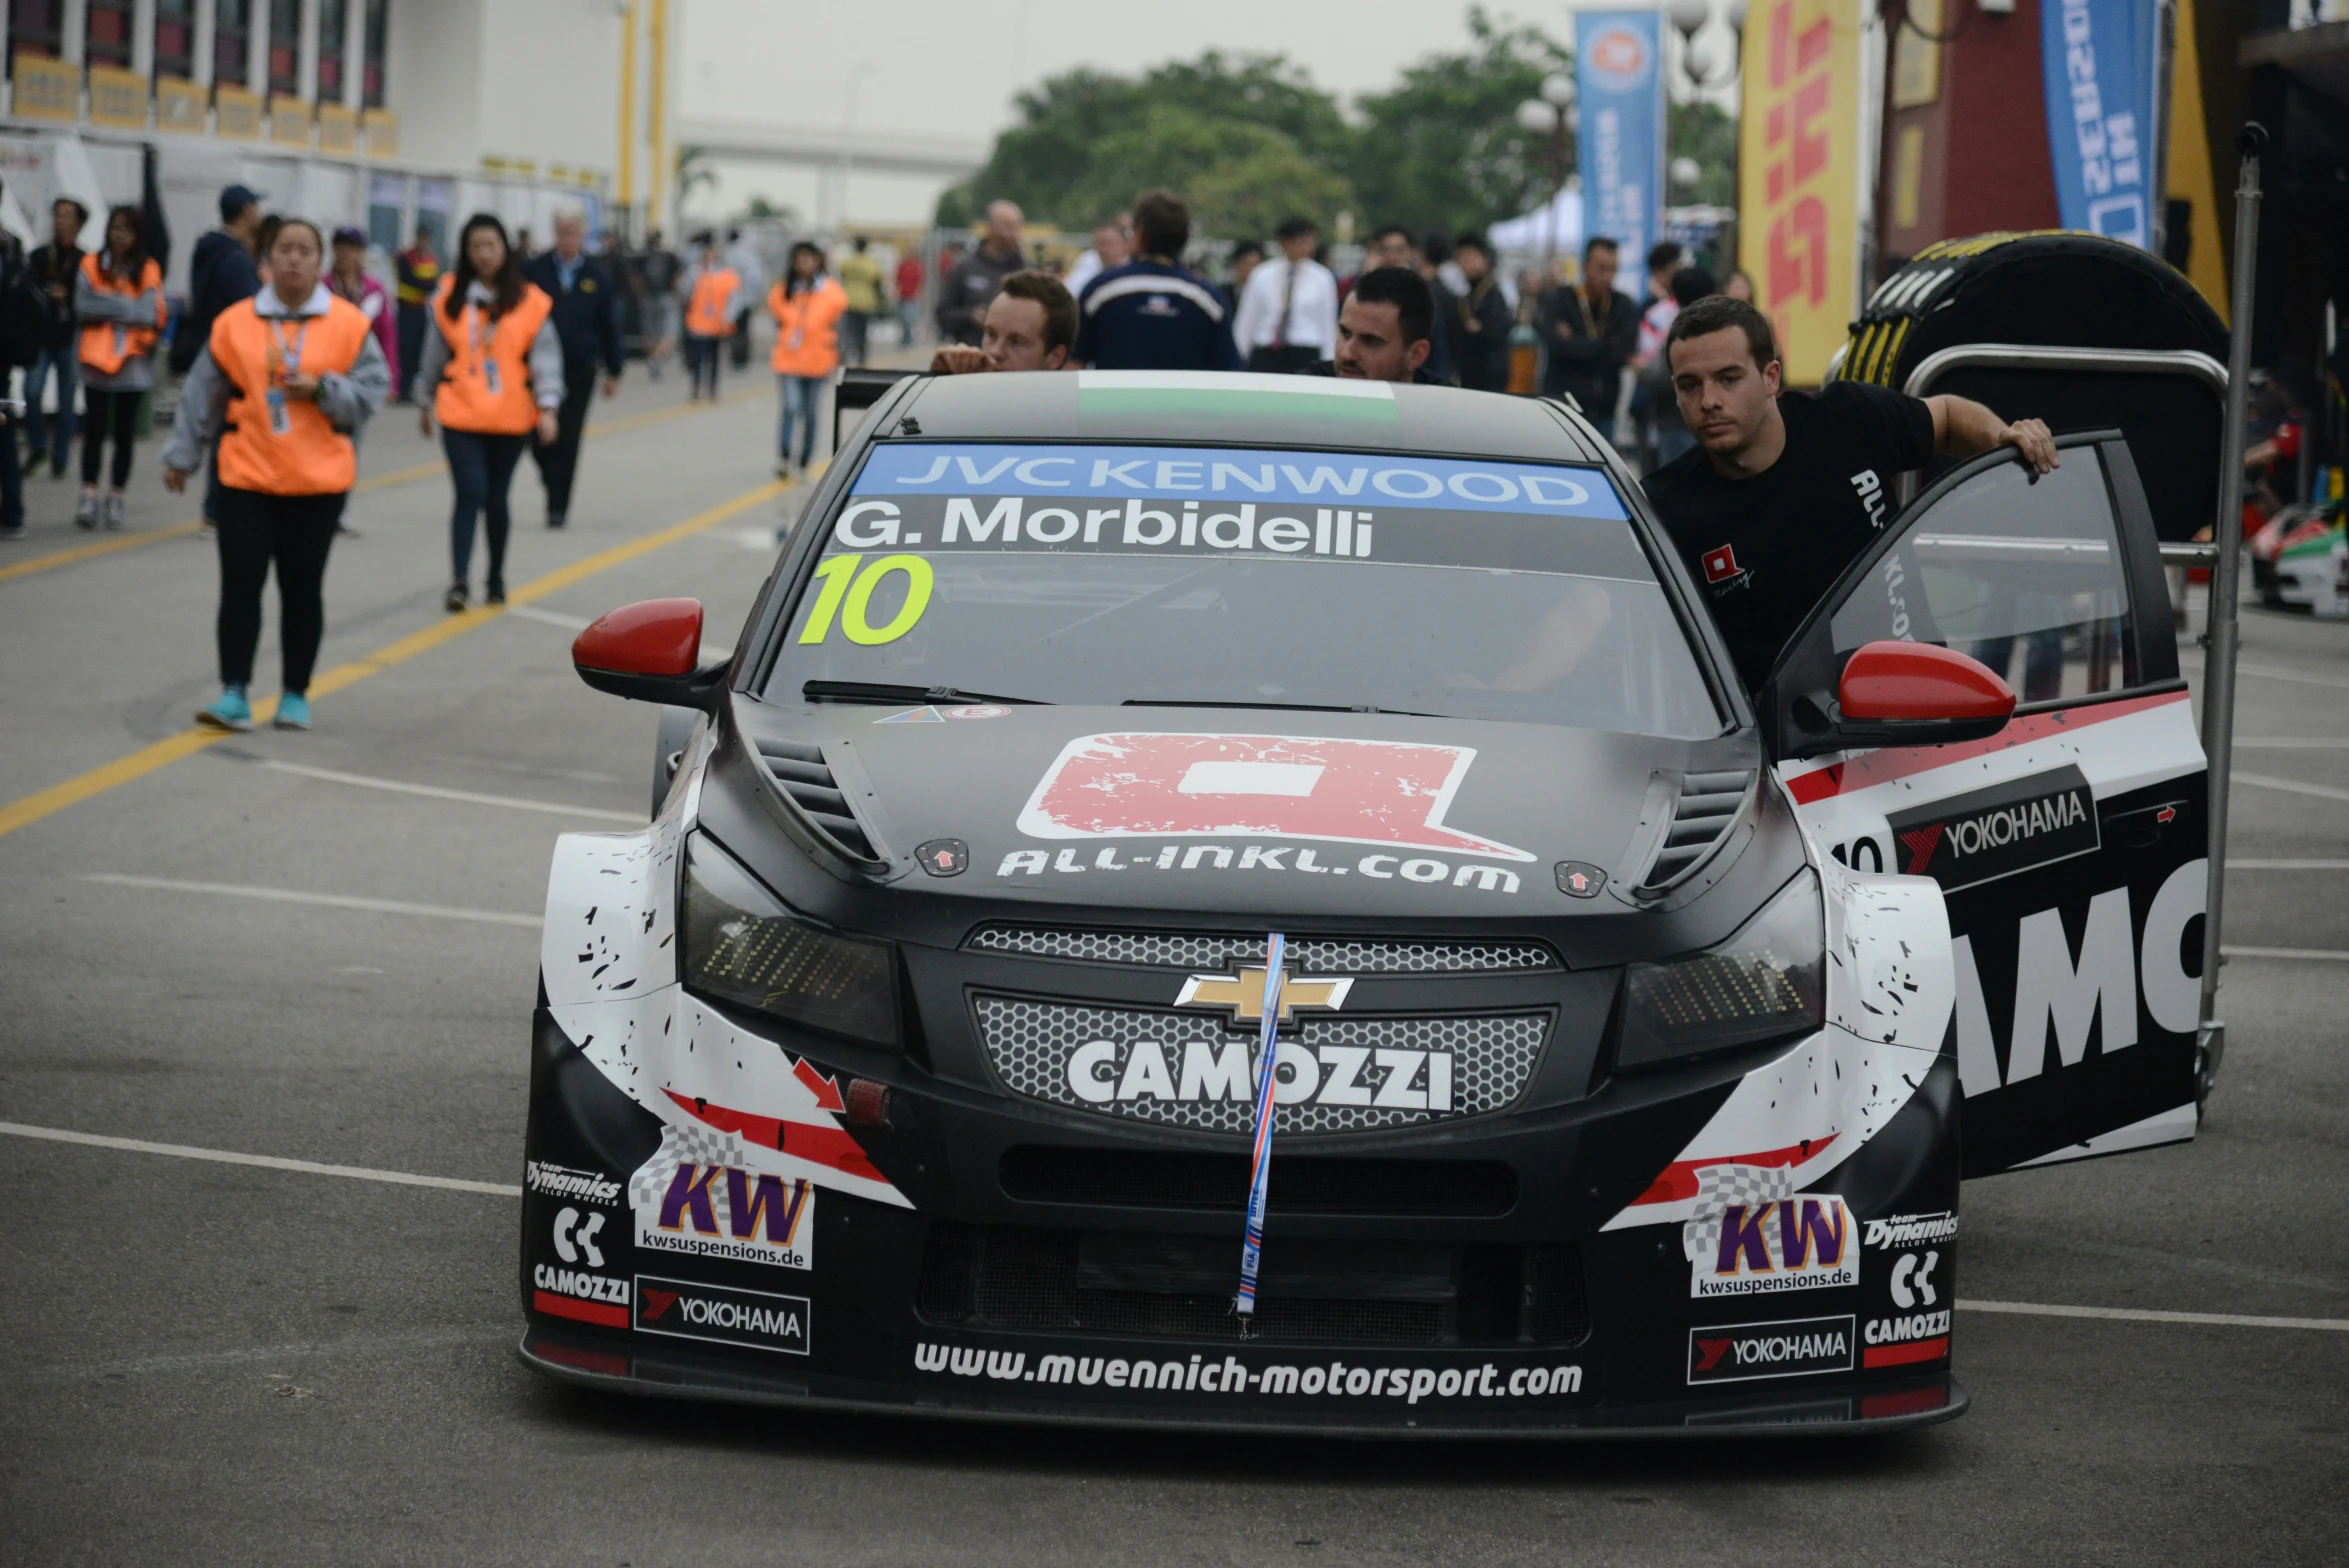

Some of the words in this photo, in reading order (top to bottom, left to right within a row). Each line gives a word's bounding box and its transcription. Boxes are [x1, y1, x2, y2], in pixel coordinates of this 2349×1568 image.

[834, 500, 922, 549] G.
[941, 497, 1373, 557] Morbidelli
[798, 554, 934, 647] 10
[1945, 791, 2087, 858] YOKOHAMA
[1067, 1040, 1452, 1111] CAMOZZI
[527, 1161, 623, 1199] Dynamics
[539, 1187, 568, 1198] ALLOY
[574, 1195, 619, 1207] WHEELS
[657, 1161, 812, 1248] KW
[642, 1229, 804, 1267] kwsuspensions.de
[1714, 1199, 1848, 1277] KW
[1863, 1210, 1959, 1250] Dynamics
[1893, 1239, 1927, 1249] ALLOY
[534, 1263, 630, 1305] CAMOZZI
[1700, 1268, 1852, 1295] kwsuspensions.de
[679, 1297, 802, 1338] YOKOHAMA
[1864, 1309, 1950, 1344] CAMOZZI
[1733, 1332, 1847, 1364] YOKOHAMA
[914, 1342, 1584, 1404] www.muennich-motorsport.com
